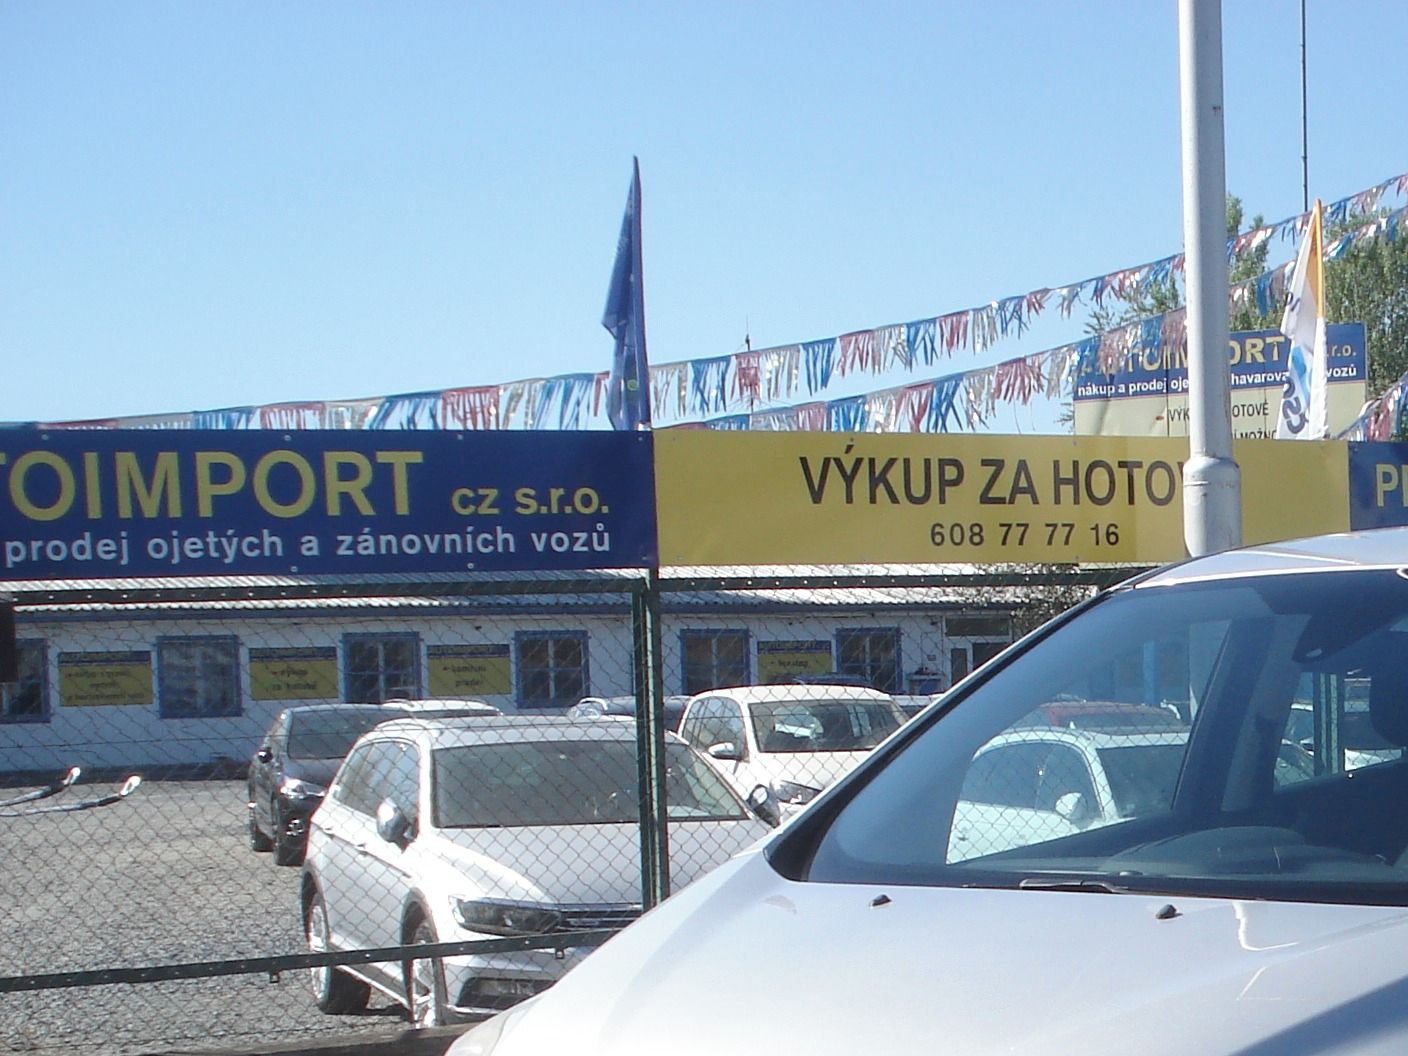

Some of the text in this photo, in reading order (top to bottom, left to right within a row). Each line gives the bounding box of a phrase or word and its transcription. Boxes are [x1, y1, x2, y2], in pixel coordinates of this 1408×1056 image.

[1078, 382, 1115, 397] nákup
[1118, 384, 1126, 393] a
[1129, 379, 1167, 395] prodej
[0, 450, 609, 520] OIMPORT cz s.r.o.
[799, 444, 965, 505] VÝKUP
[979, 459, 1039, 505] ZA
[5, 523, 610, 567] prodej ojetých a zánovních vozů
[931, 523, 1119, 546] 608 77 77 16
